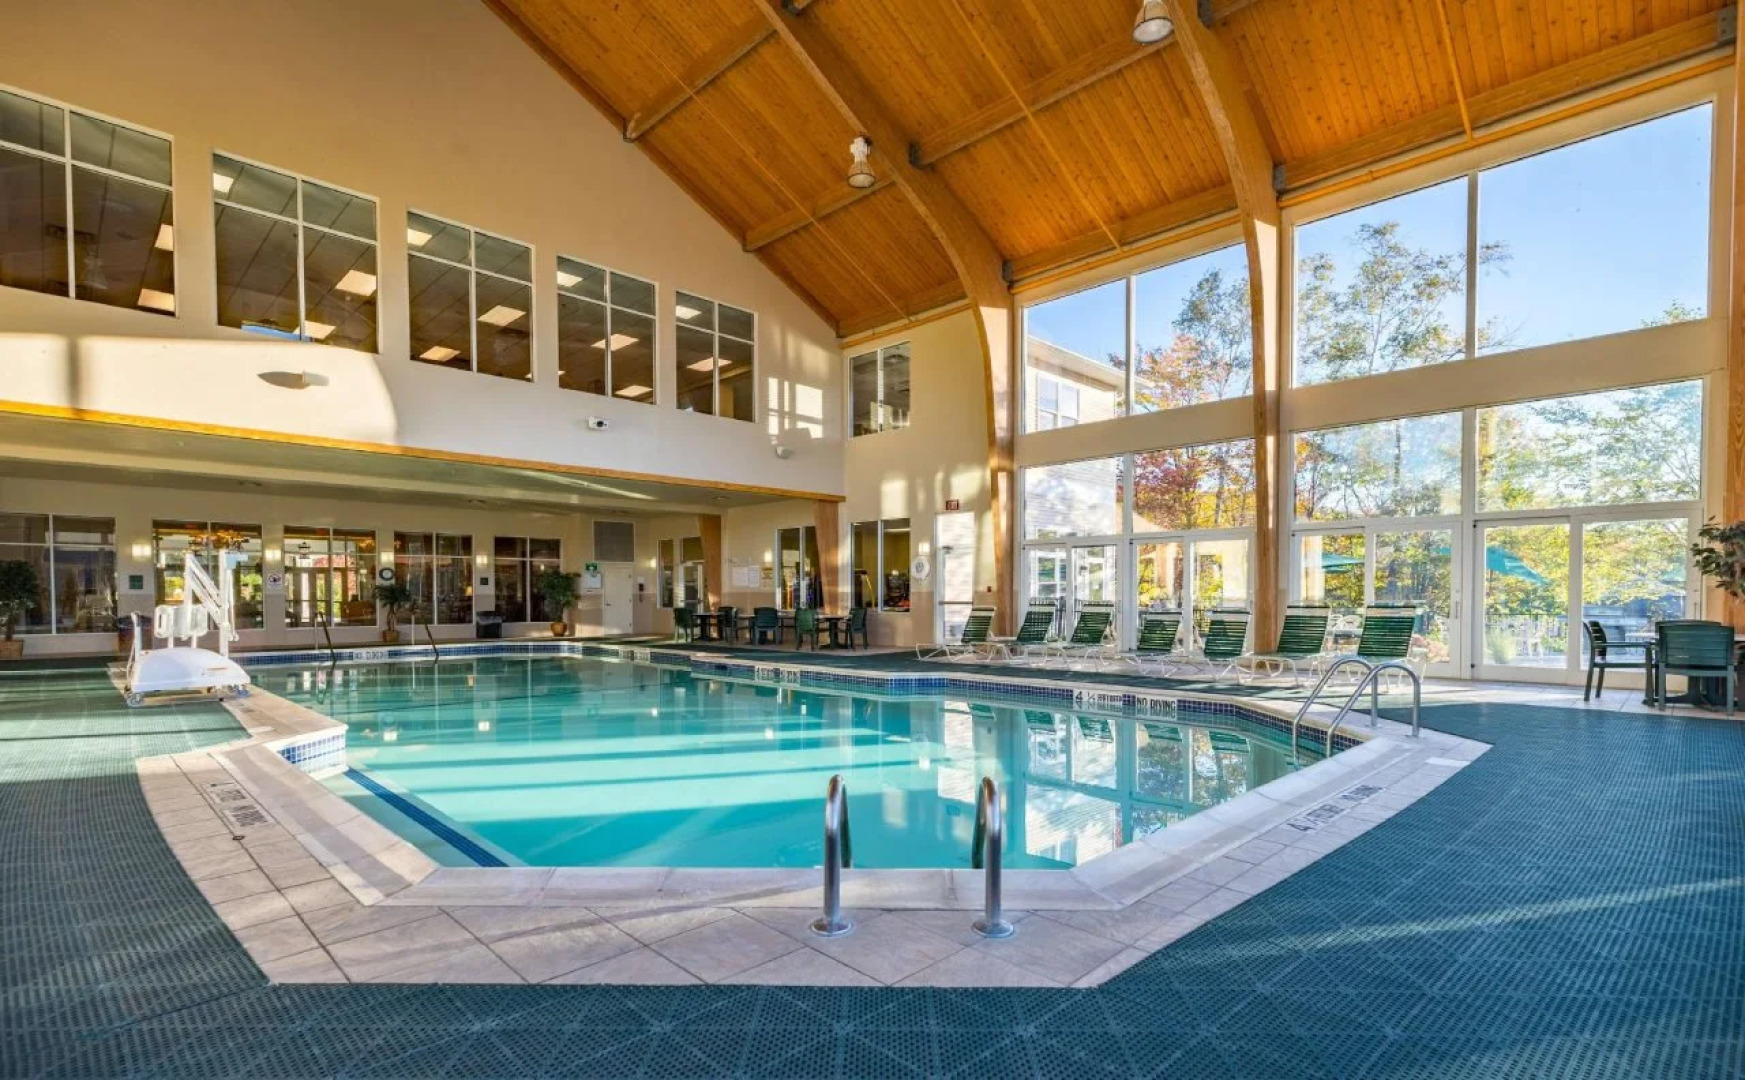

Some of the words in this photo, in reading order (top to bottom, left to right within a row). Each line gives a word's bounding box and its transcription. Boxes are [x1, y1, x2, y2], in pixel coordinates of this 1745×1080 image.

[1075, 690, 1083, 700] 4
[1137, 697, 1147, 706] NO
[1150, 699, 1176, 710] DIVING
